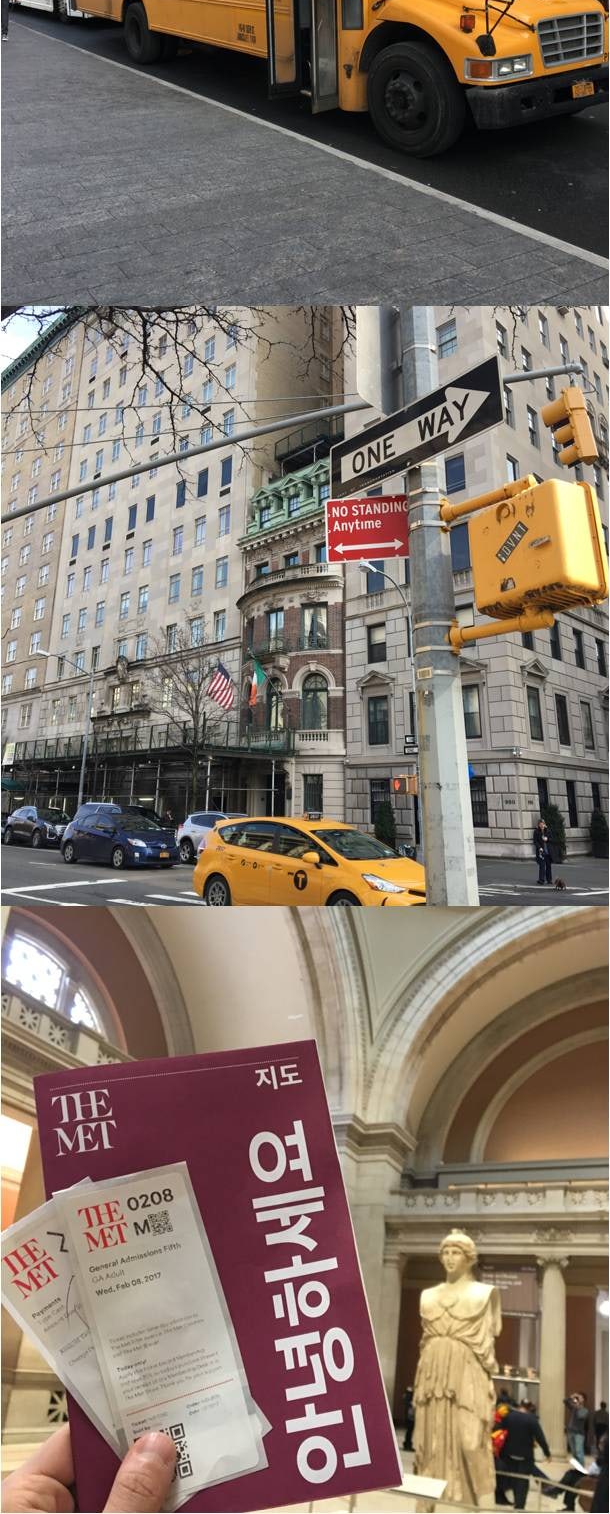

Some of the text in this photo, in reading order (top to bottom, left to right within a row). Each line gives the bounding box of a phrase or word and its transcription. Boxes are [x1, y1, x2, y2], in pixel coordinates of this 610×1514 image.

[352, 393, 470, 474] ONE WAY
[331, 498, 409, 518] NO STANDING
[333, 518, 382, 533] Anytime
[255, 1063, 302, 1090] 지도
[51, 1089, 113, 1123] THE
[53, 1120, 117, 1157] MET
[127, 1188, 174, 1211] 0208
[77, 1200, 124, 1229] THE
[133, 1218, 151, 1236] M
[83, 1222, 128, 1253] MET
[1, 1238, 48, 1276] THE
[89, 1242, 182, 1273] General Admissions Fifth
[11, 1256, 59, 1300] MET
[92, 1269, 125, 1283] GA Adult
[96, 1285, 116, 1296] Wed,
[116, 1282, 130, 1291] Feb
[144, 1271, 161, 1282] 2017
[32, 1297, 62, 1319] Payments
[248, 1119, 372, 1484] 안녕하세요
